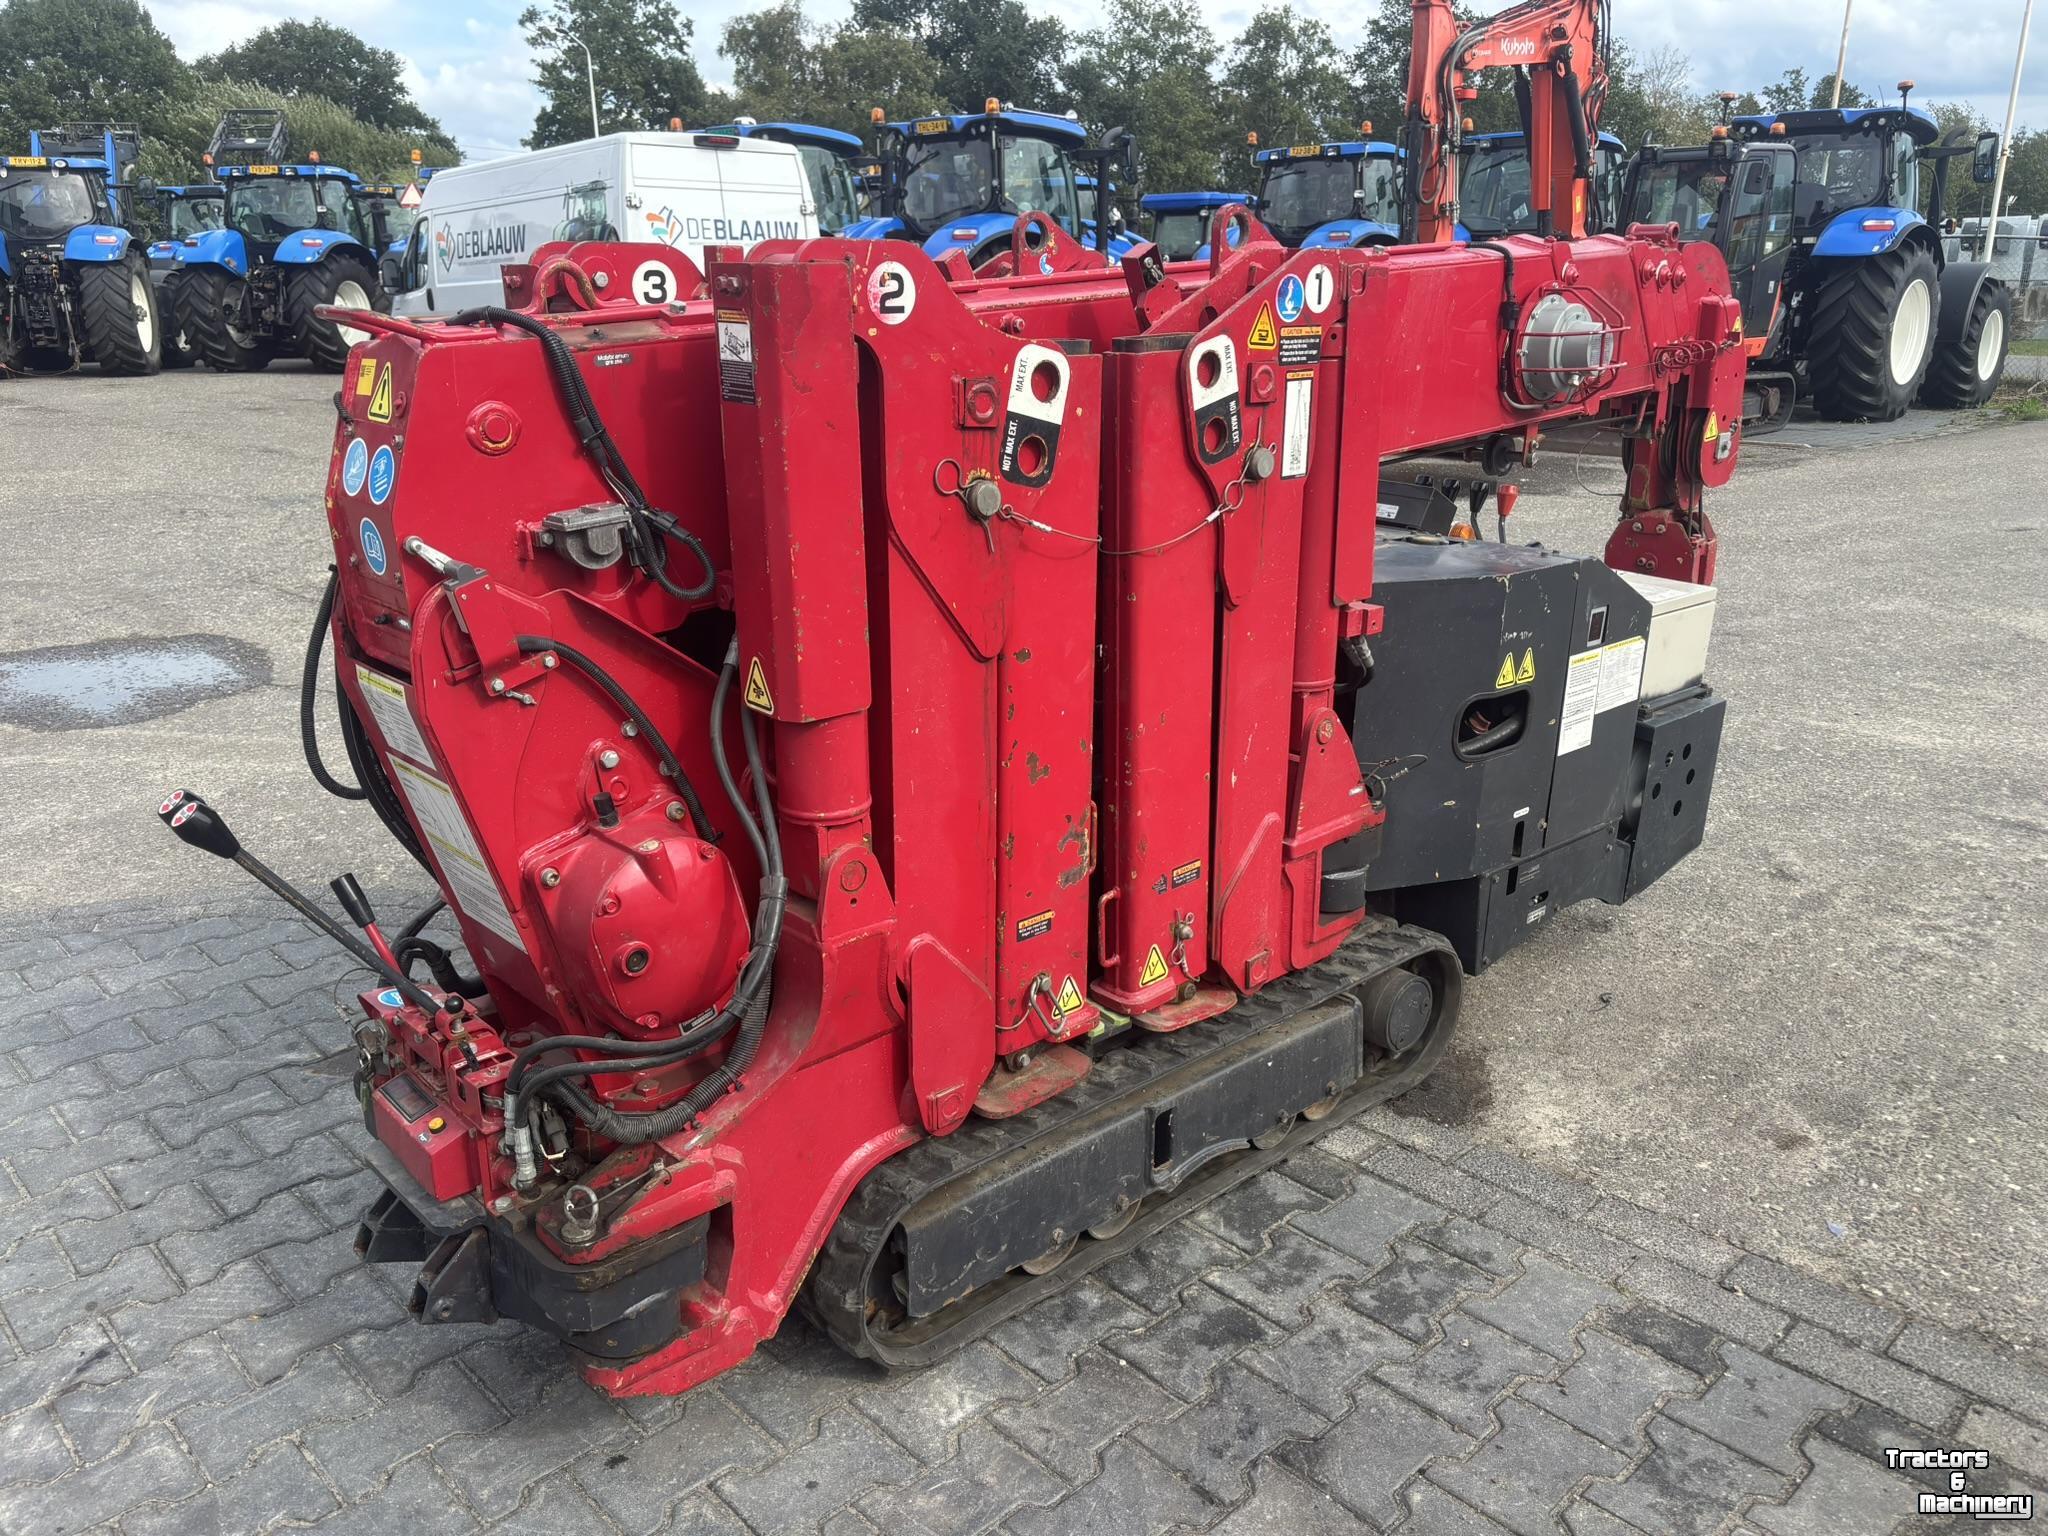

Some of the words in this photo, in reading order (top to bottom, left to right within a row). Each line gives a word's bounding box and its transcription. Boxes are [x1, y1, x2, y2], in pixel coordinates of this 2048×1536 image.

[686, 217, 799, 241] DEBLAAUW
[643, 269, 667, 304] 3
[879, 271, 905, 314] 2
[1315, 267, 1325, 305] 1
[1224, 344, 1232, 361] MAX
[1019, 357, 1029, 374] EXT.
[1015, 373, 1025, 392] MAX
[1008, 419, 1019, 436] EXT.
[1231, 415, 1239, 431] MAX
[1005, 436, 1015, 455] MAX
[1002, 455, 1012, 472] NOT
